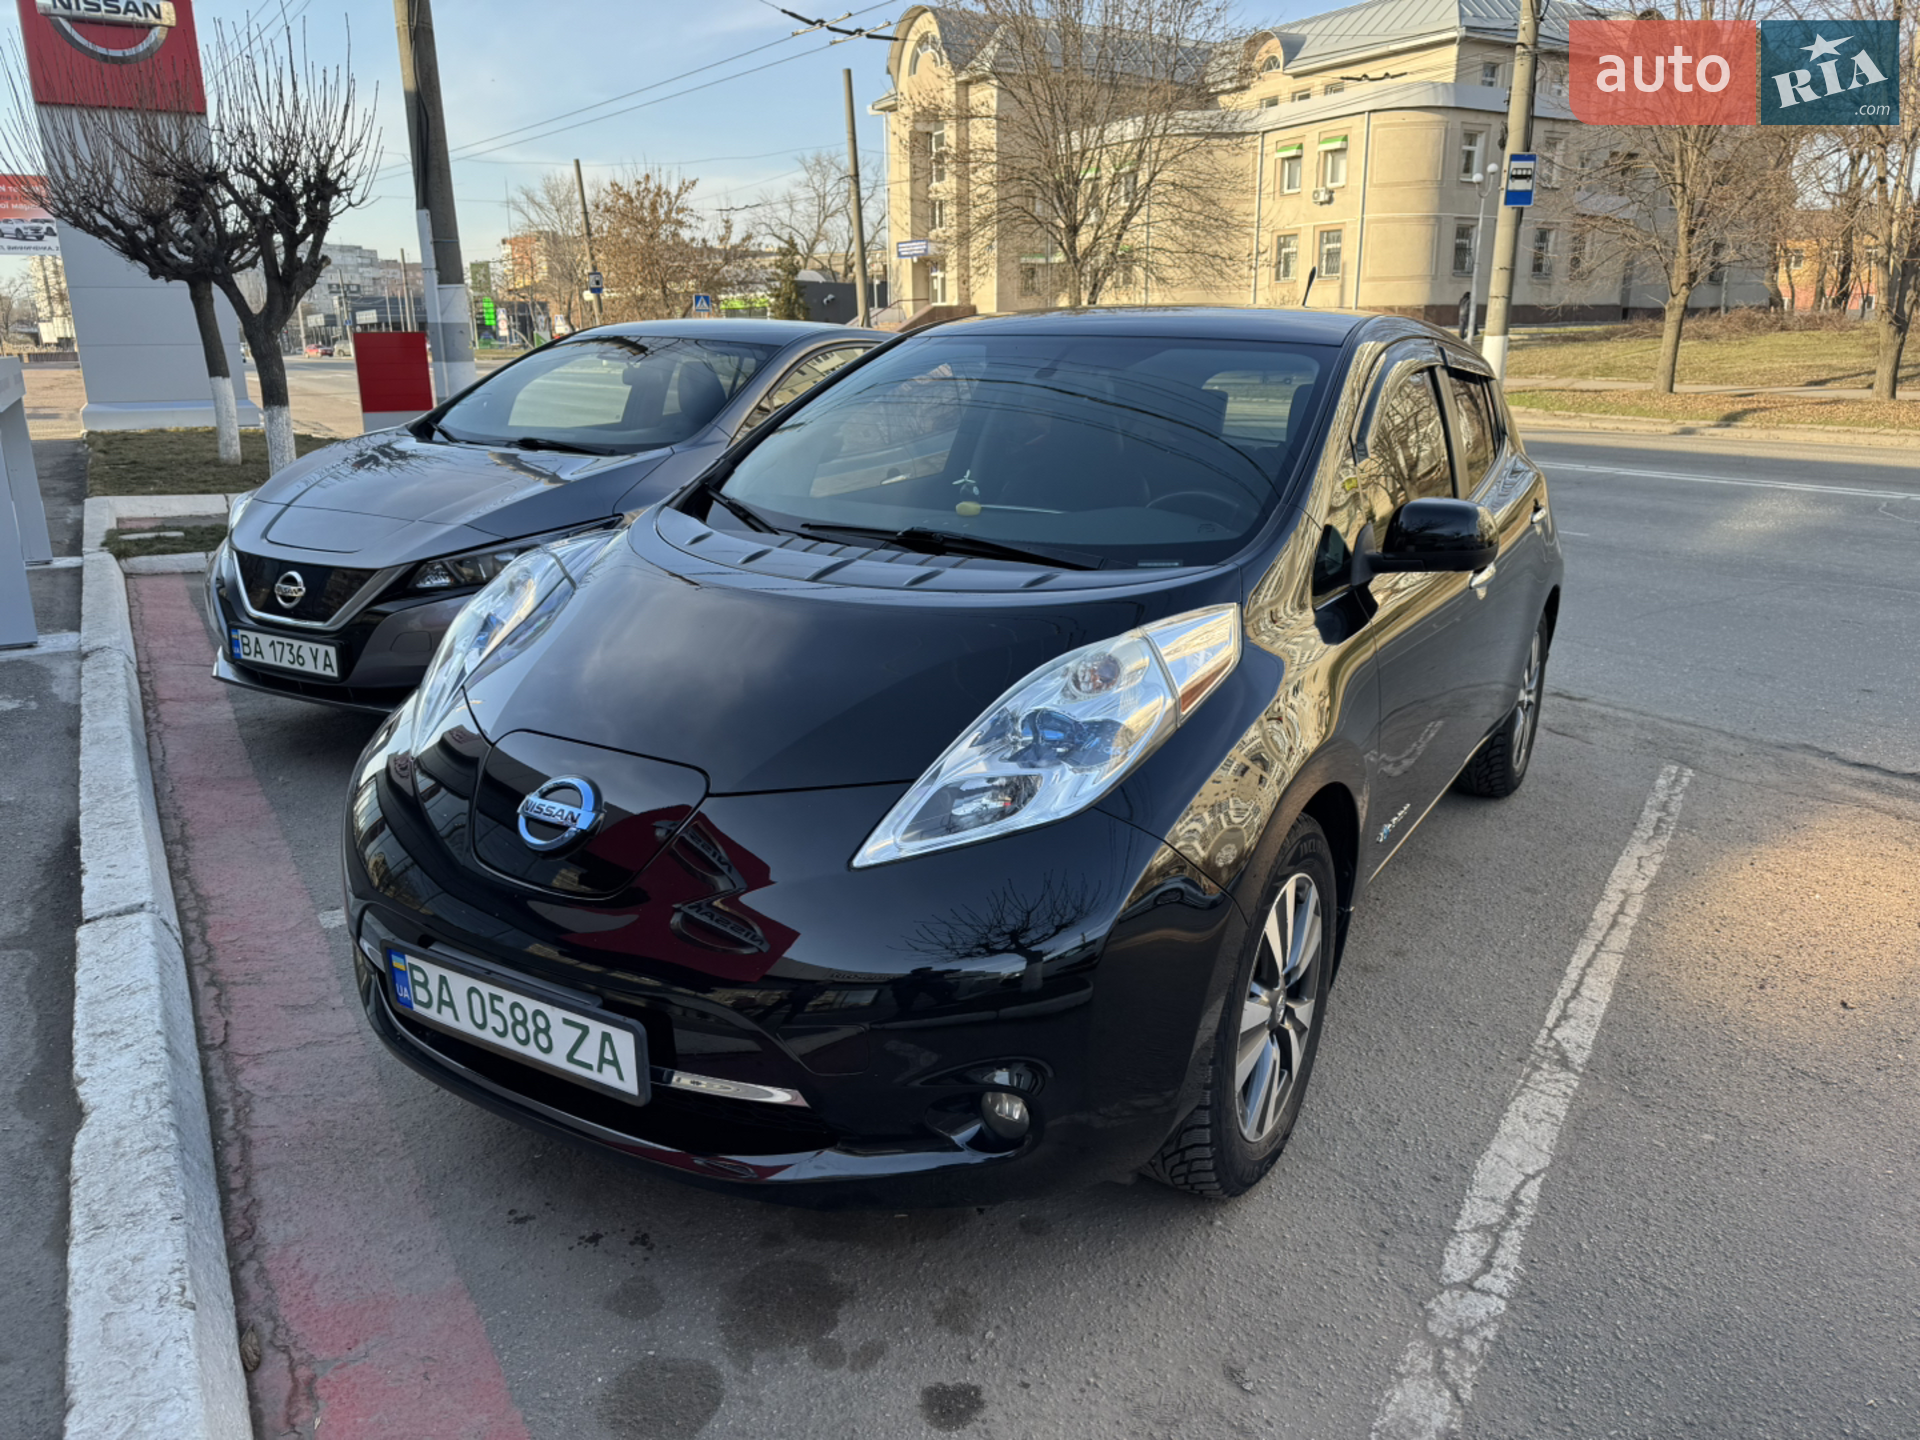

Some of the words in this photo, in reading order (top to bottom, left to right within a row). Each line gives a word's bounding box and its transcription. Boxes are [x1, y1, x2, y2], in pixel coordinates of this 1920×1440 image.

[53, 0, 162, 20] NISSAN
[240, 634, 265, 660] BA
[268, 639, 306, 667] 1736
[308, 646, 335, 673] YA
[523, 800, 581, 824] NISSAN
[396, 983, 410, 1000] UA
[407, 961, 460, 1022] BA
[466, 986, 554, 1054] 0588
[561, 1017, 625, 1082] ZA
